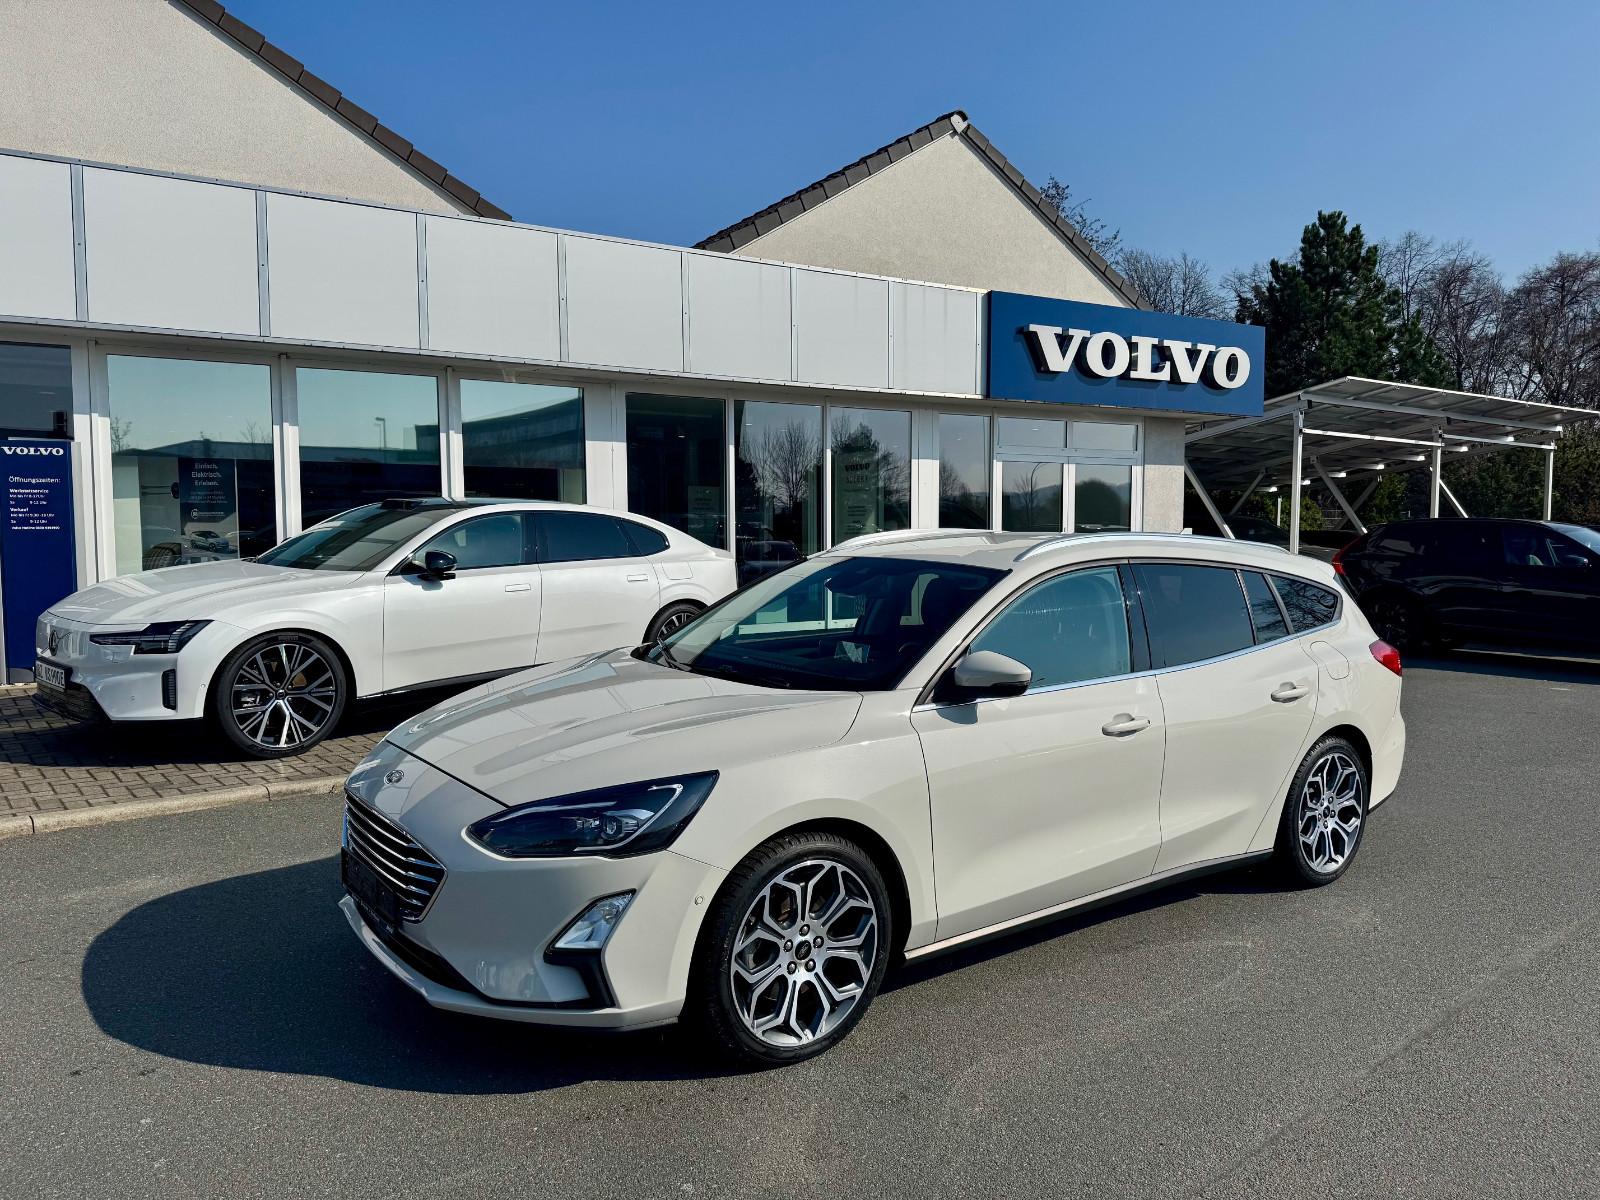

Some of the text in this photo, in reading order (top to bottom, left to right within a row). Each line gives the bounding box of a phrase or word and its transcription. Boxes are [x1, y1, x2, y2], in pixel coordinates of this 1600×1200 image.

[1027, 323, 1251, 389] VOLVO
[1, 446, 64, 456] VOLVO
[845, 463, 870, 472] VOLVO
[8, 475, 61, 484] Öffnungszeiten:
